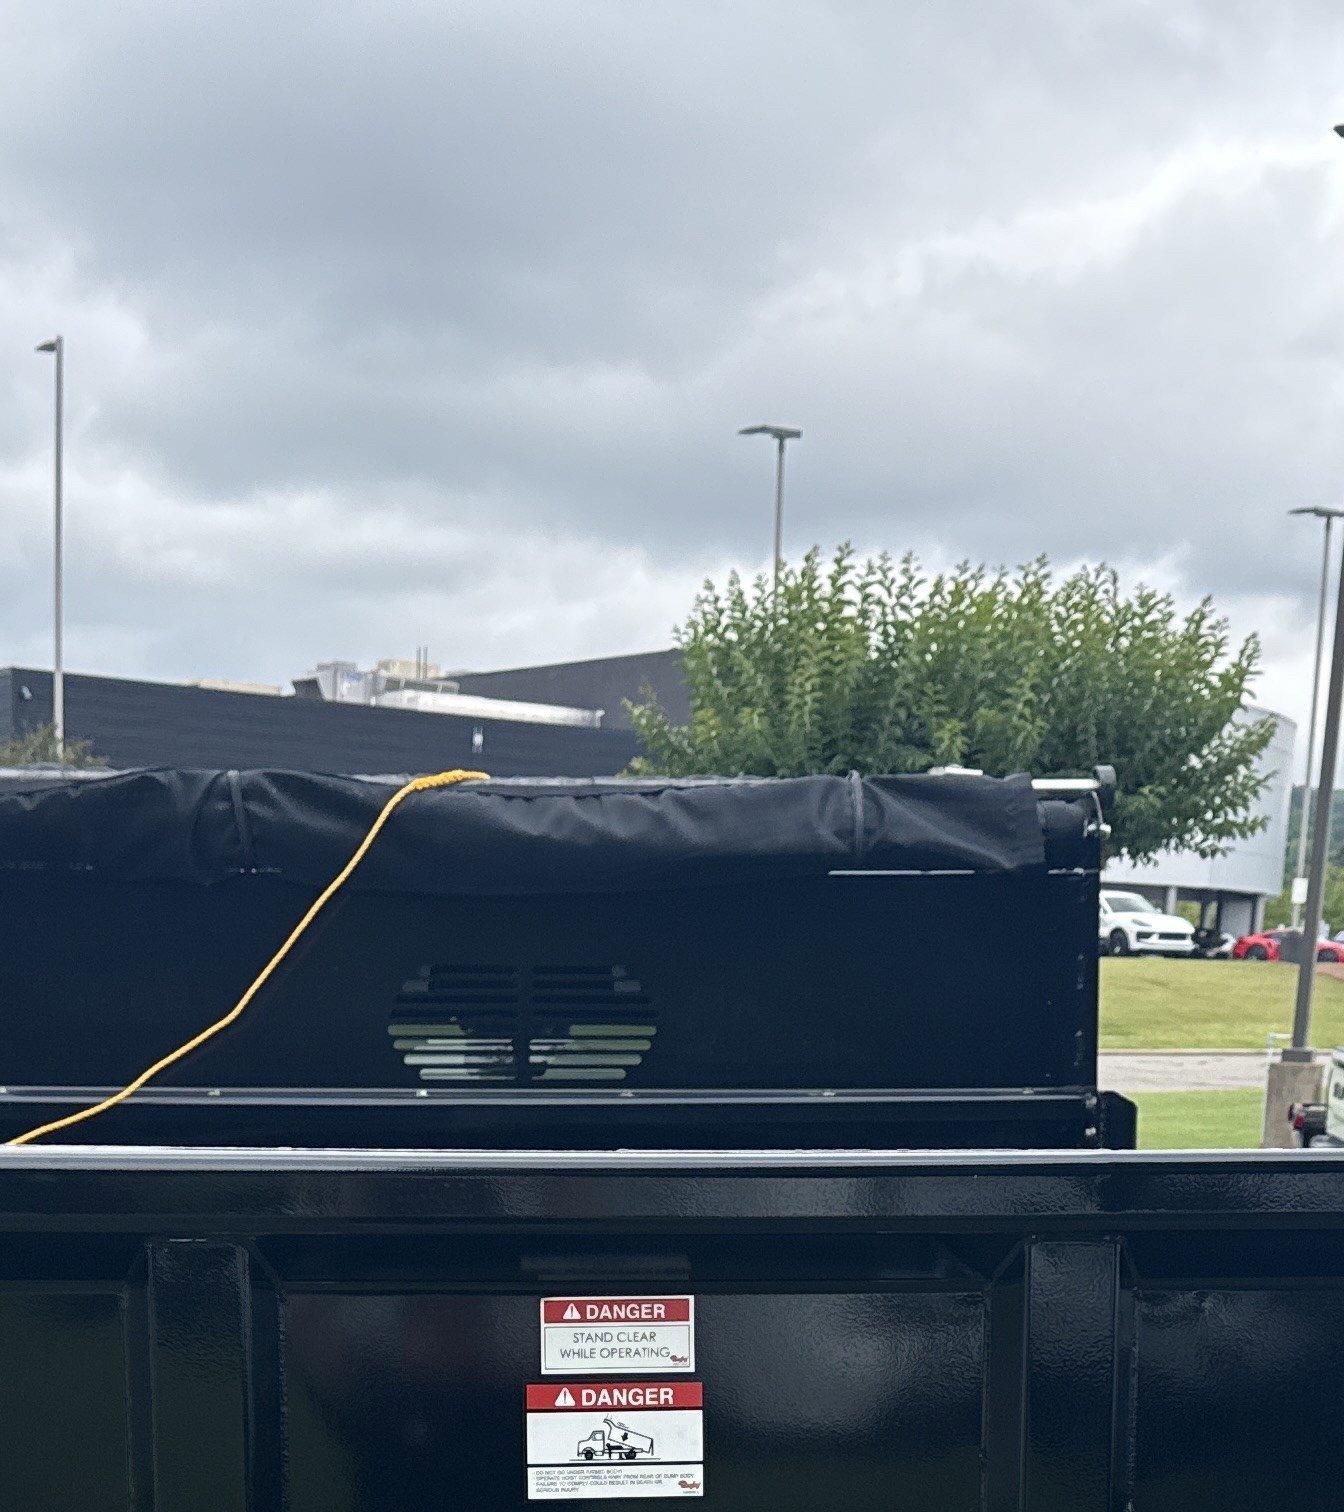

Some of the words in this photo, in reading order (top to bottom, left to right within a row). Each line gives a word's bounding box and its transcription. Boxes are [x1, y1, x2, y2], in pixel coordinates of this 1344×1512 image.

[586, 1303, 666, 1320] DANGER
[573, 1332, 614, 1343] STAND
[616, 1331, 657, 1343] CLEAR
[560, 1348, 596, 1359] WHILE
[599, 1346, 671, 1358] OPERATING
[581, 1387, 674, 1406] DANGER
